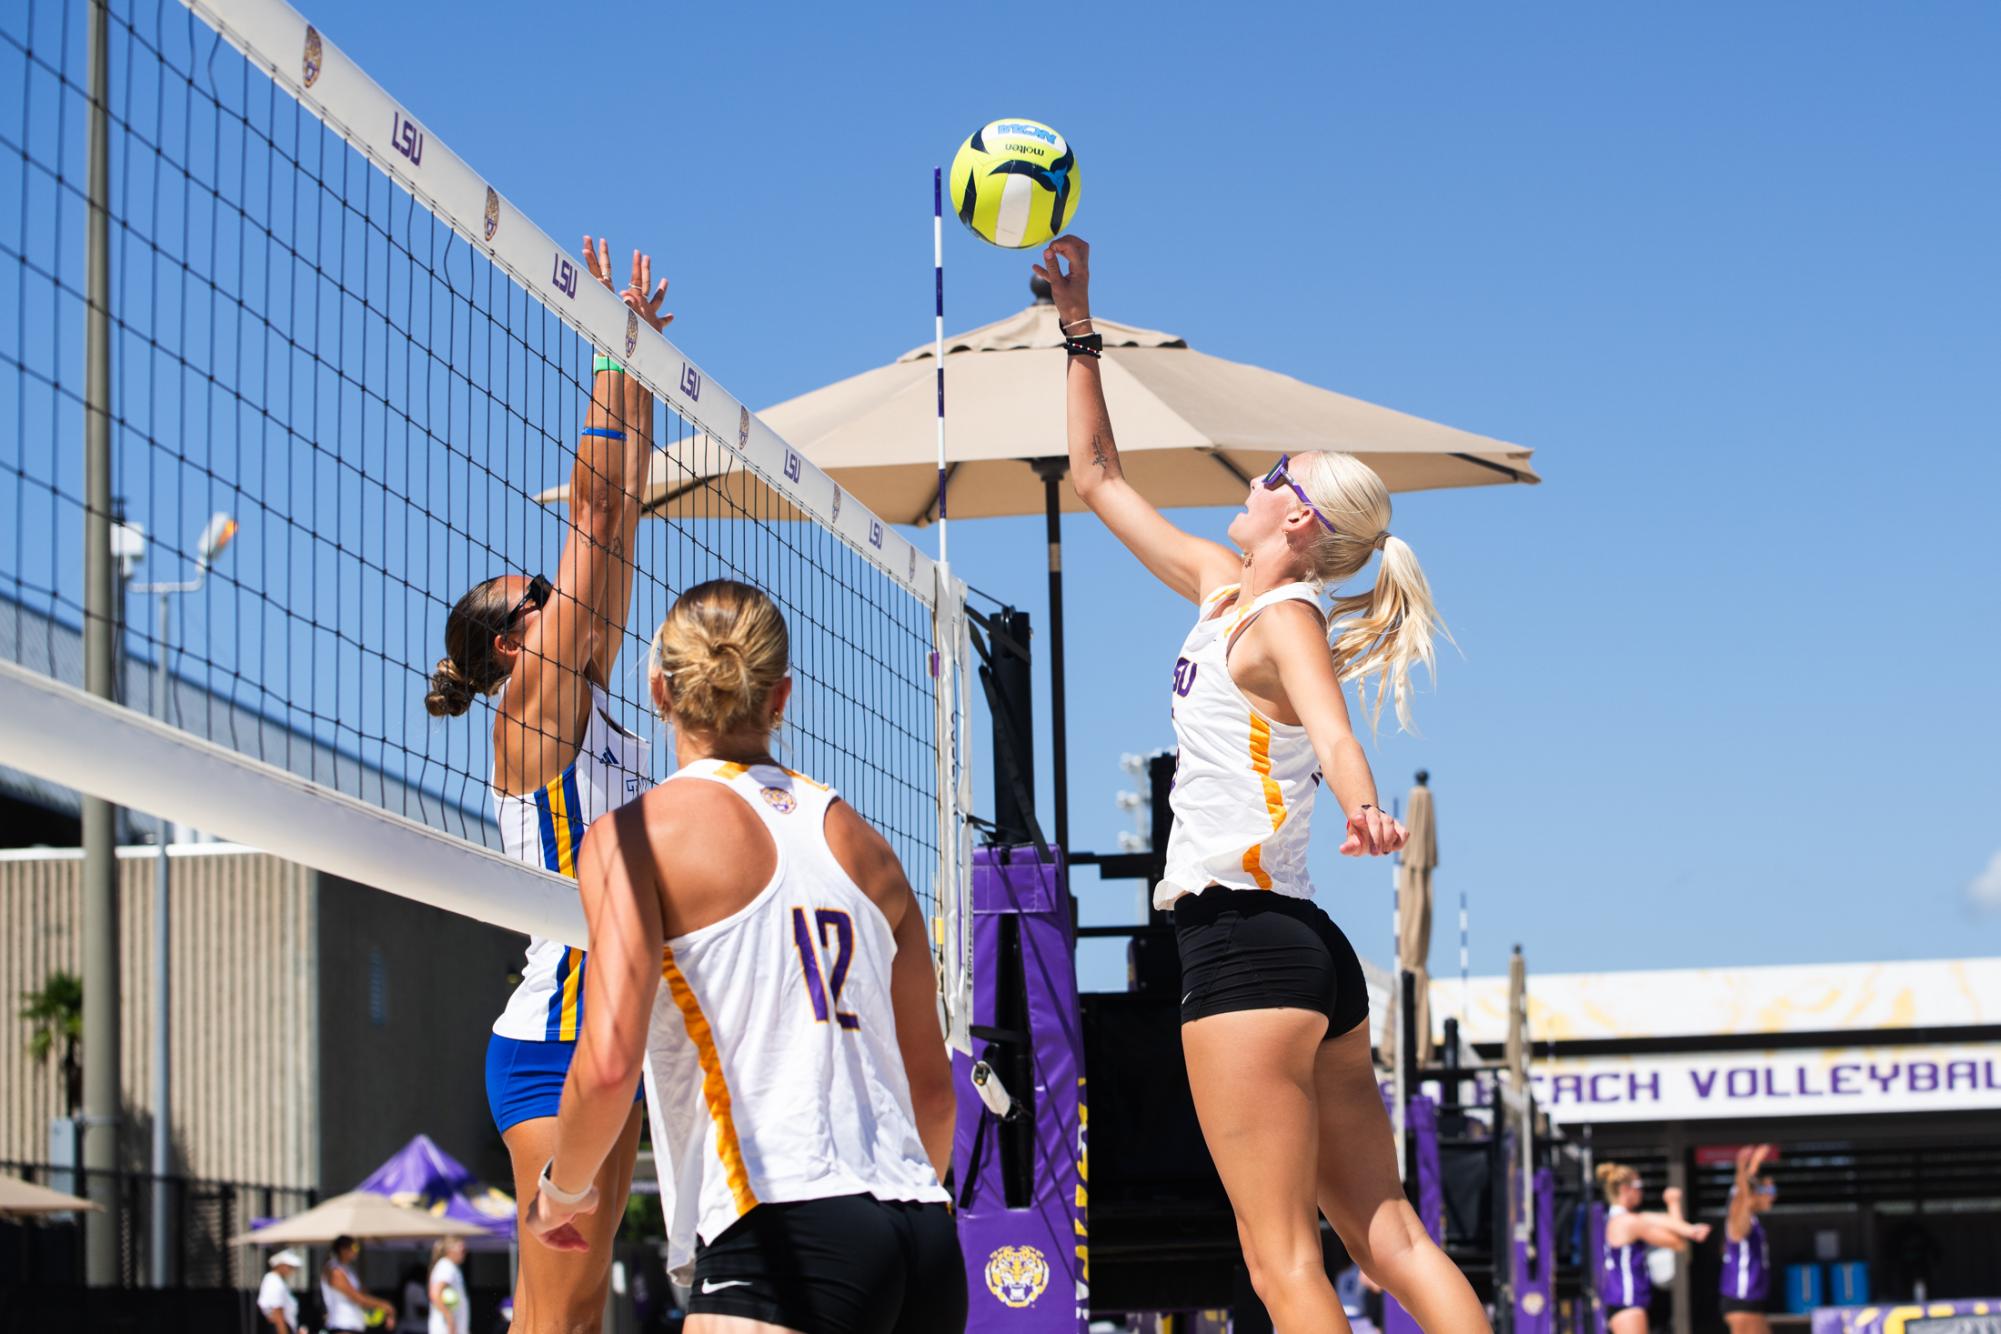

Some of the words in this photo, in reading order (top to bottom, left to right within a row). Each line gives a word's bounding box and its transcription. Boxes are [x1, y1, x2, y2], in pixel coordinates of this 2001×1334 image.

[391, 110, 424, 168] LSU
[1005, 144, 1045, 157] molten
[552, 252, 578, 300] LSU
[680, 361, 701, 402] LSU
[783, 448, 801, 484] LSU
[868, 518, 883, 551] LSU
[1172, 656, 1198, 698] SU
[791, 906, 861, 1031] 12
